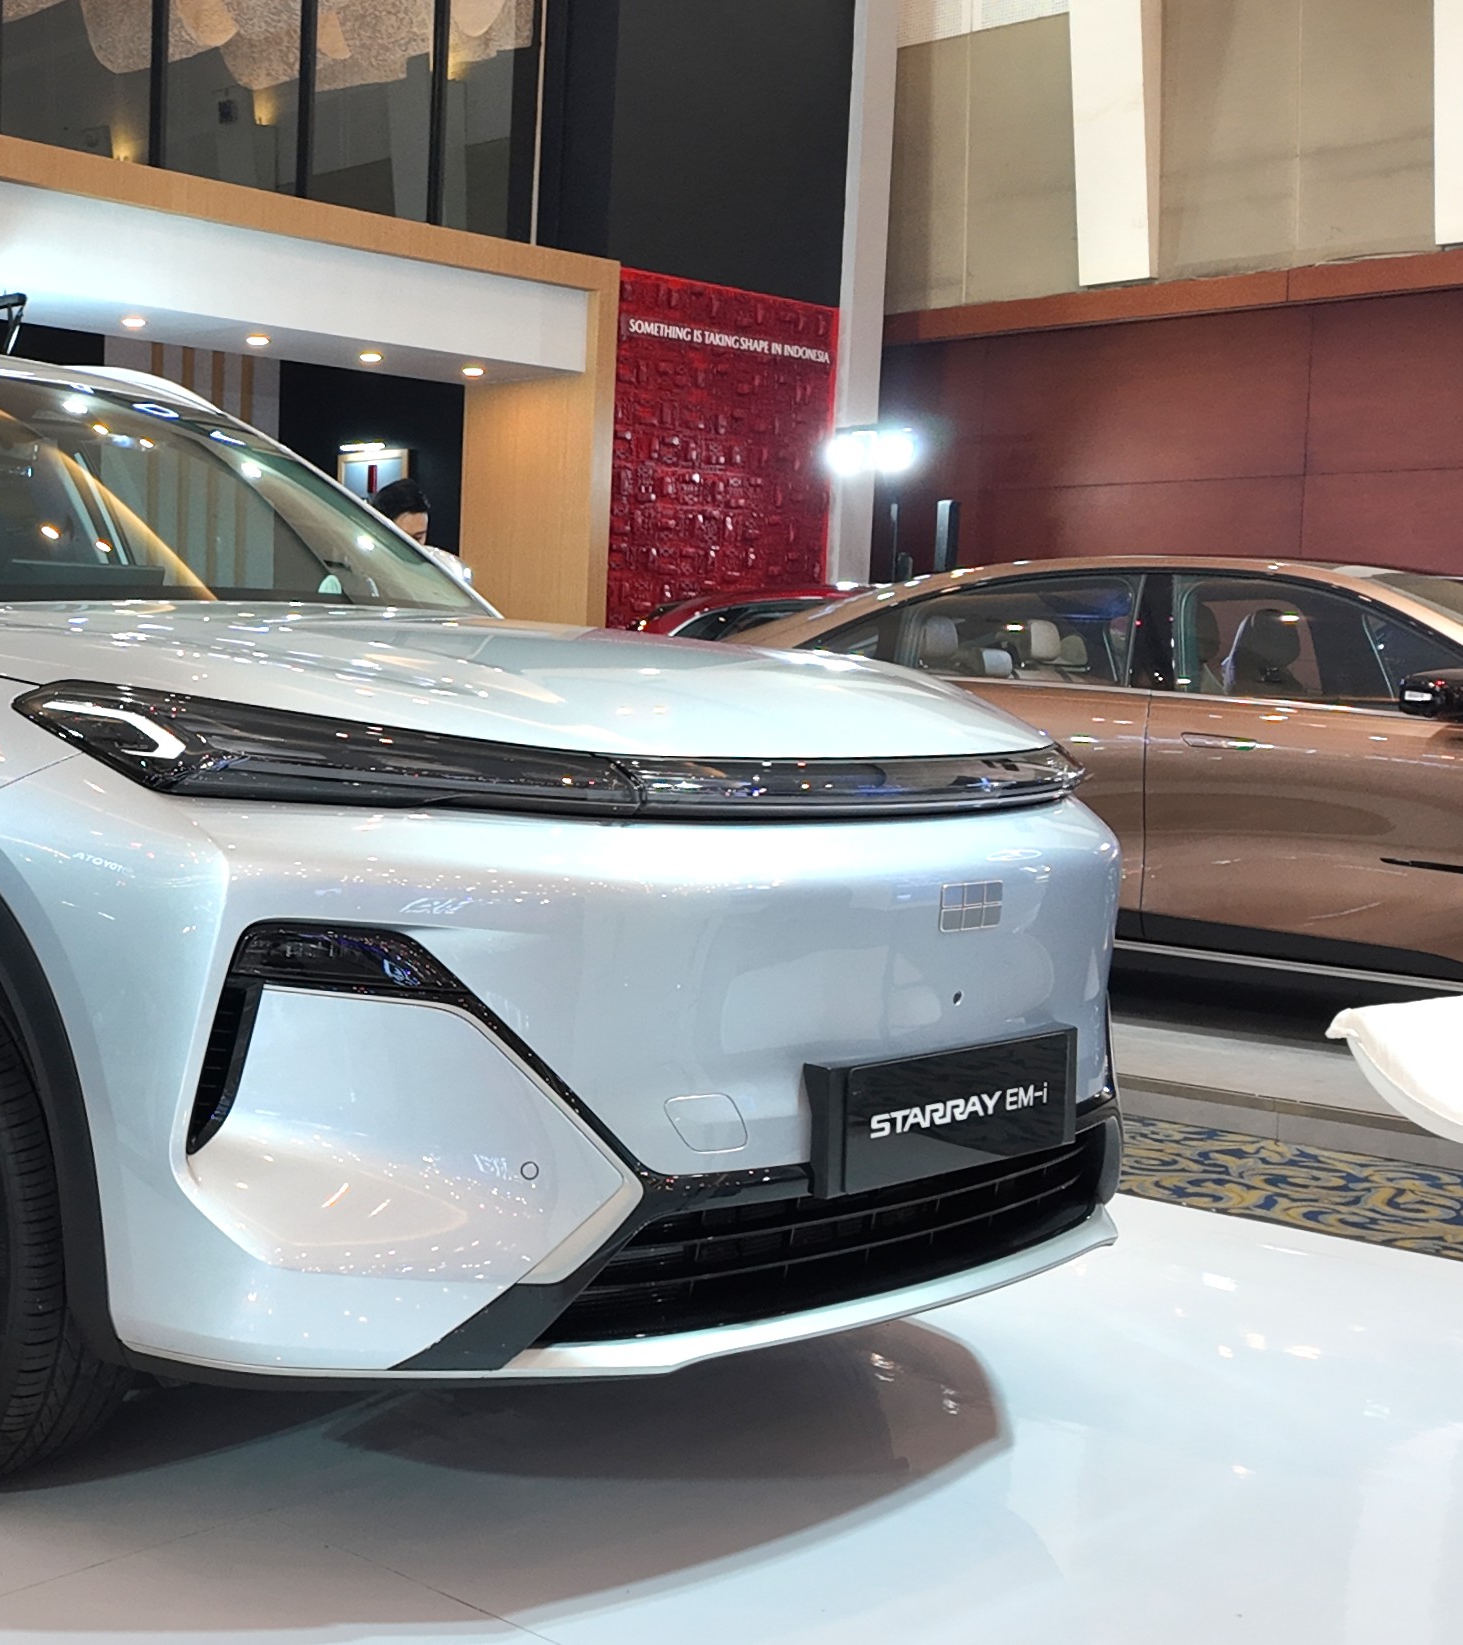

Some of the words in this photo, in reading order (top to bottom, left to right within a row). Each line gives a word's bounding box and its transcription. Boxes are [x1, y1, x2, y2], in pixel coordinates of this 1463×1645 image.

[628, 319, 692, 341] SOMETHING
[693, 331, 703, 343] IS
[704, 331, 739, 349] TAKING
[739, 337, 769, 354] SHAPE
[771, 342, 782, 355] IN
[784, 344, 830, 365] INDONESIA
[870, 1090, 1002, 1139] STARRAY
[1005, 1082, 1048, 1111] EM-i
